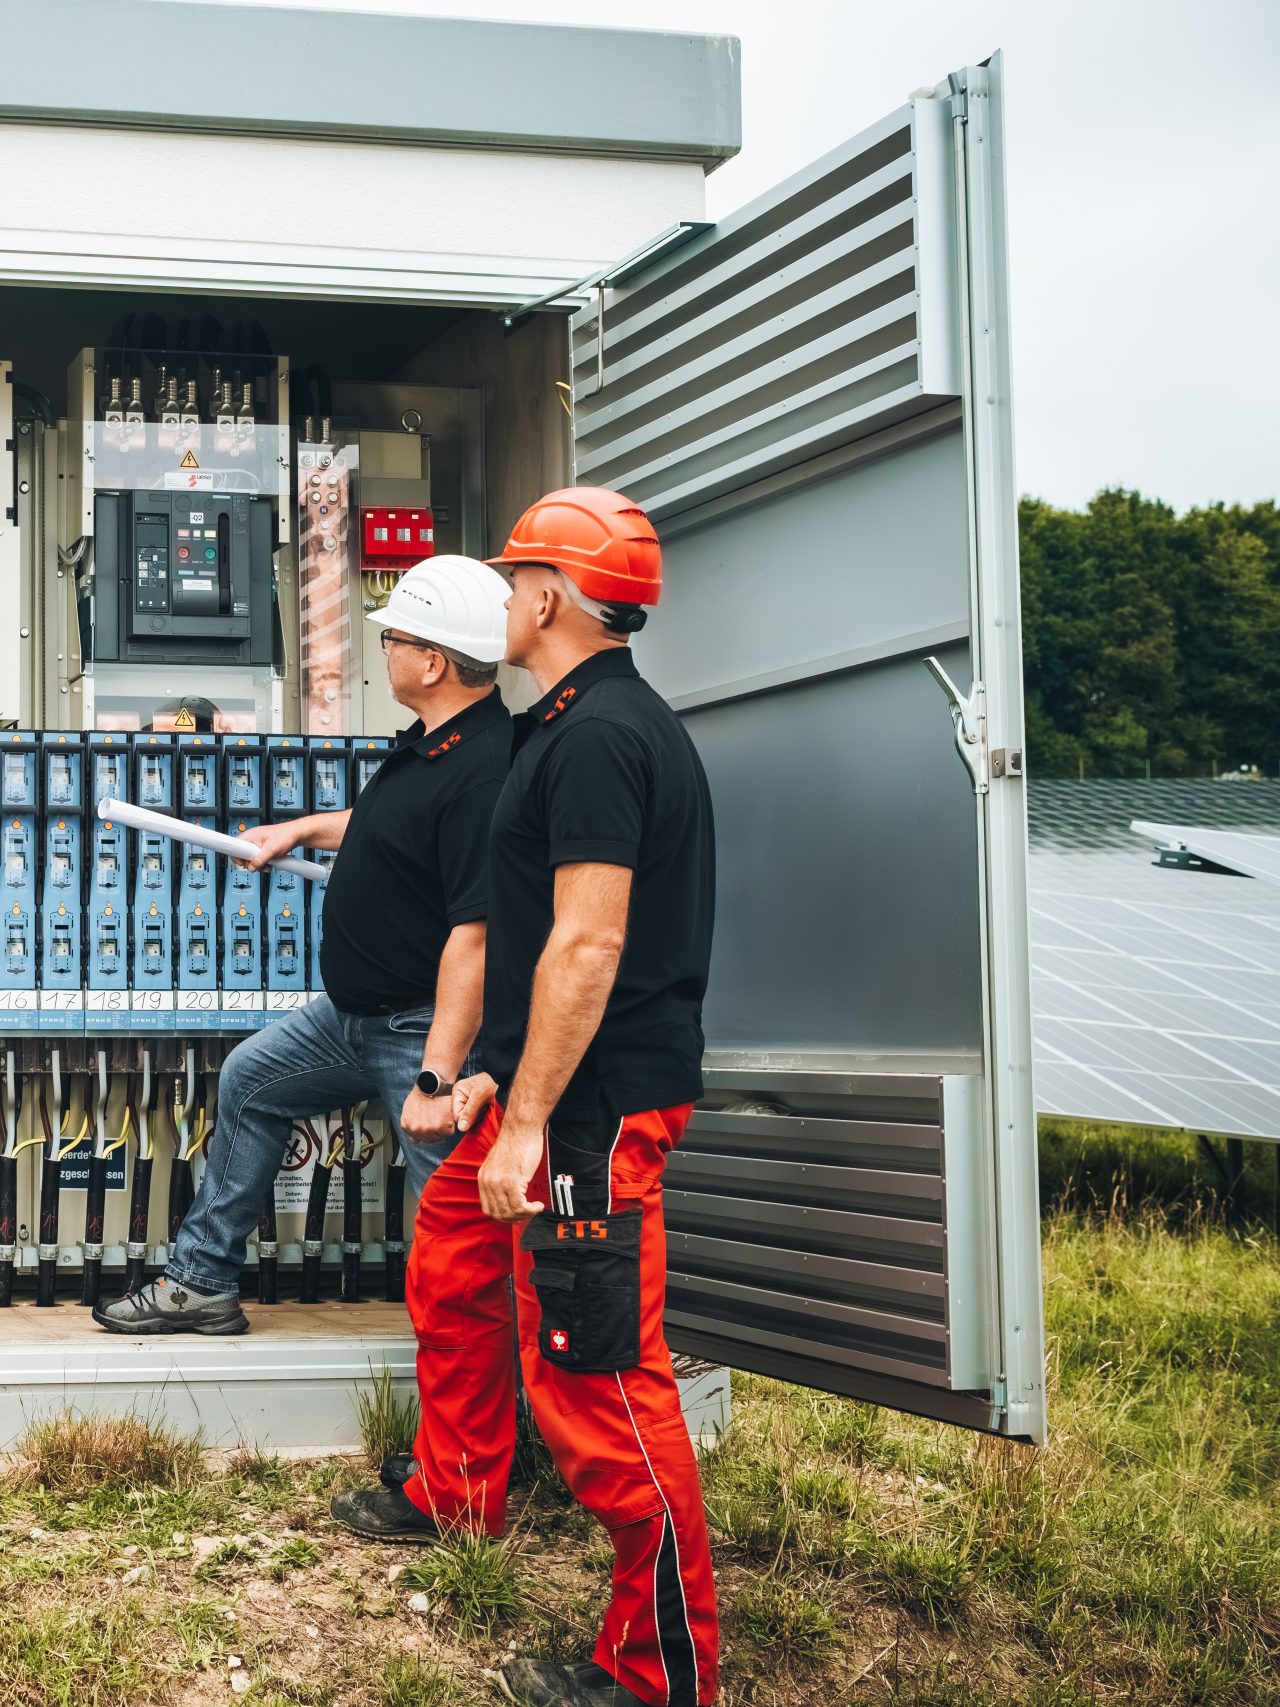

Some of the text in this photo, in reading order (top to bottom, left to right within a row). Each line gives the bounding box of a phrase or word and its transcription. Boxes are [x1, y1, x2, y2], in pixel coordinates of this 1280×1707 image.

[0, 991, 27, 1009] 16
[45, 992, 77, 1009] 17
[92, 991, 122, 1010] 18
[134, 991, 162, 1009] 19
[186, 991, 213, 1009] 20
[228, 991, 255, 1009] 21
[273, 992, 300, 1009] 22
[557, 1220, 608, 1240] ETS
